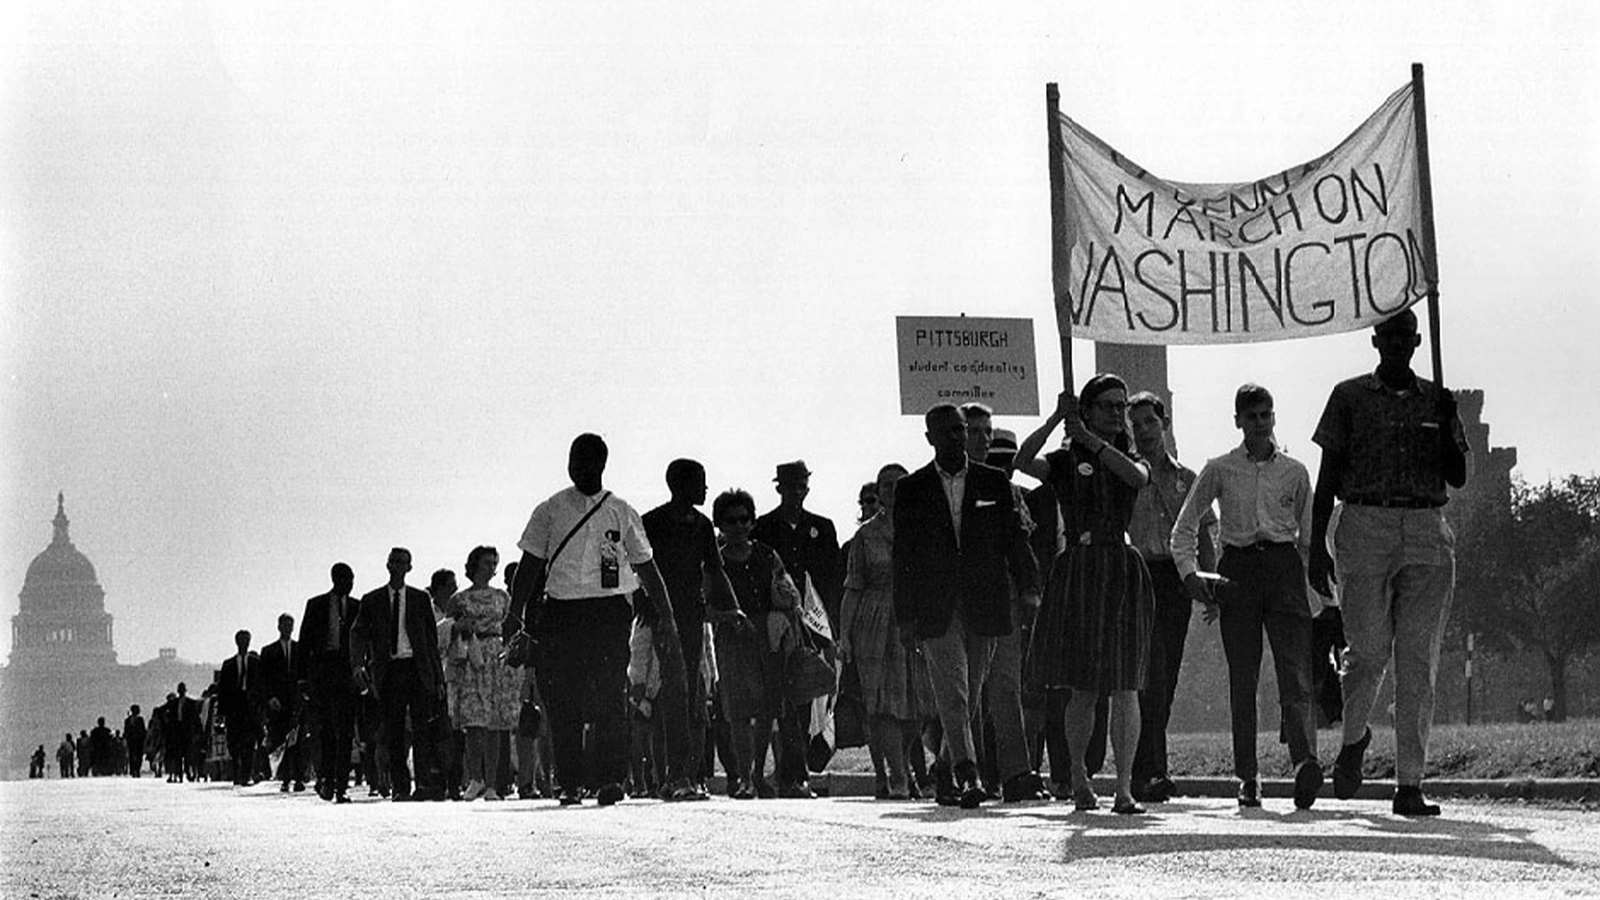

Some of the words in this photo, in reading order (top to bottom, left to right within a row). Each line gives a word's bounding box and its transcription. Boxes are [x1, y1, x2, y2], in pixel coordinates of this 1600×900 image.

[1114, 184, 1303, 249] MARCH
[1314, 162, 1388, 224] ON
[916, 329, 1008, 348] PITTSBURGH
[909, 360, 949, 373] student
[937, 385, 997, 399] committee
